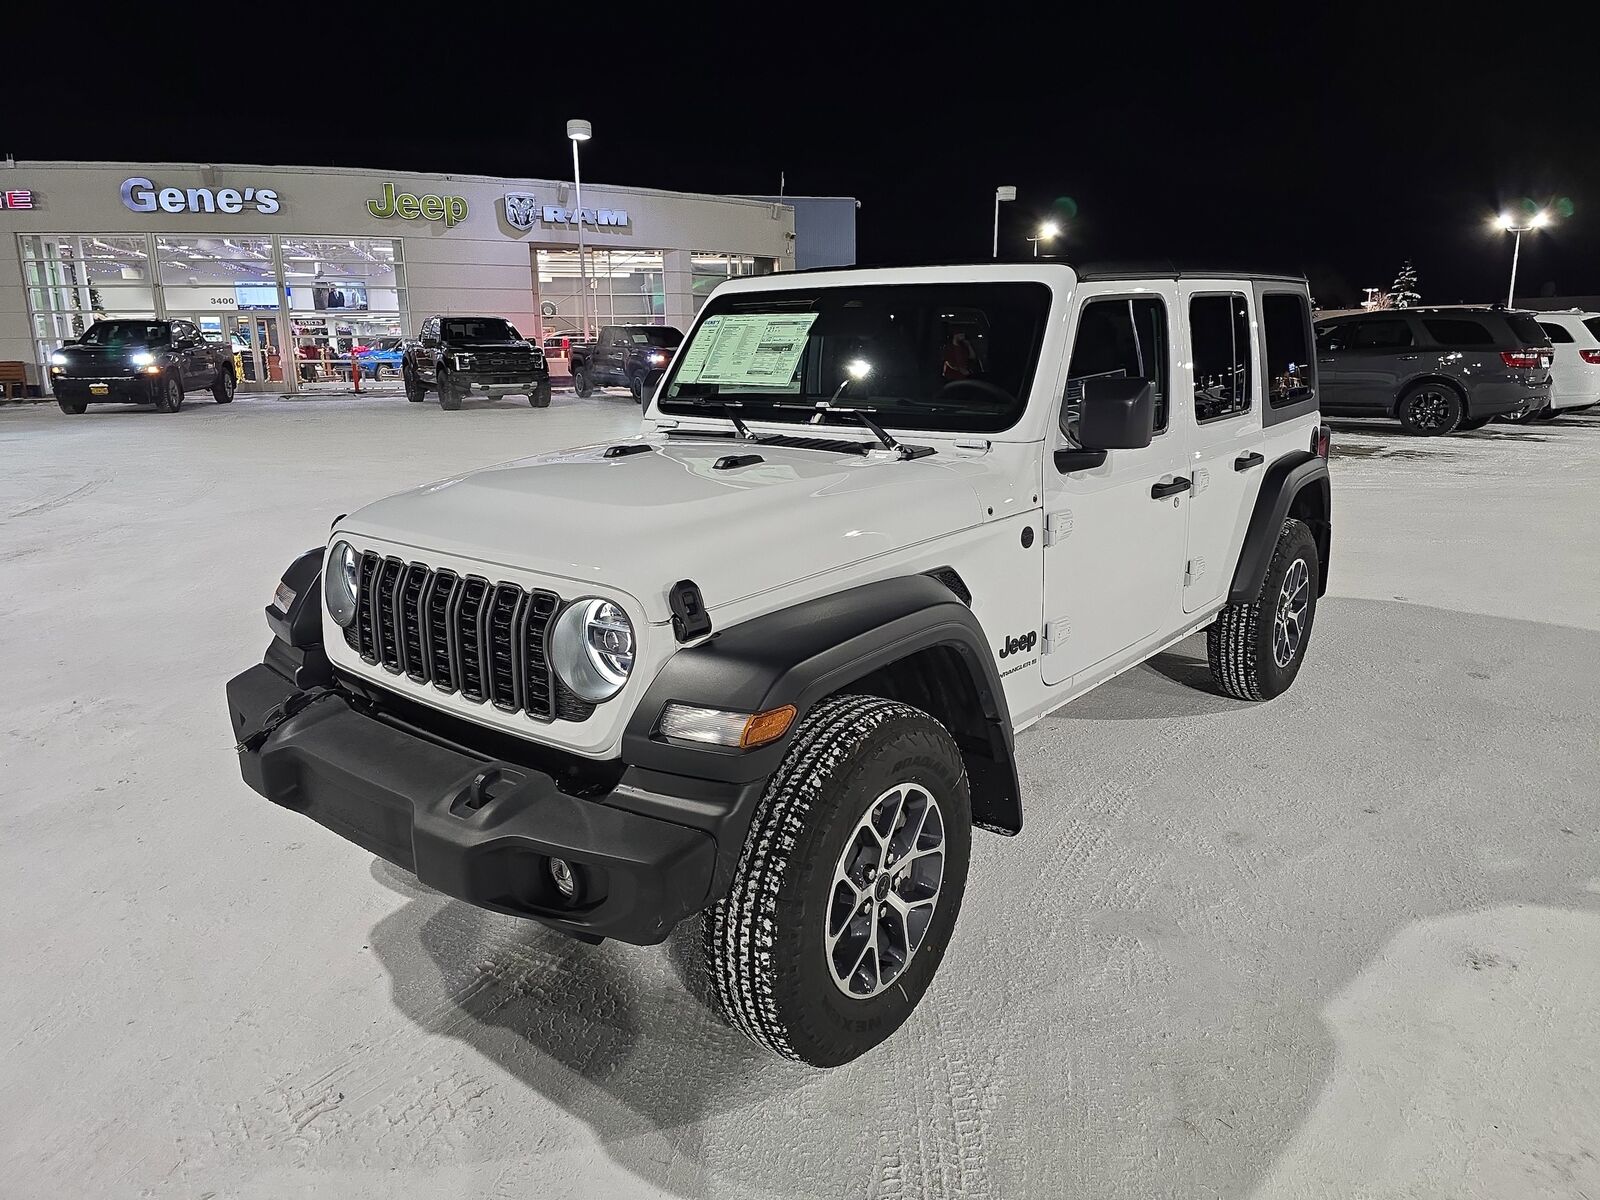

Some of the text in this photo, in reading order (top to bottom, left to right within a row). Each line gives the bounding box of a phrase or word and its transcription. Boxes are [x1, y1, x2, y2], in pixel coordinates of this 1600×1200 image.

[0, 190, 33, 209] E
[120, 177, 280, 214] Gene's
[366, 182, 470, 228] Jeep
[541, 205, 629, 227] RAM
[210, 297, 235, 305] 3400
[999, 631, 1037, 658] Jeep
